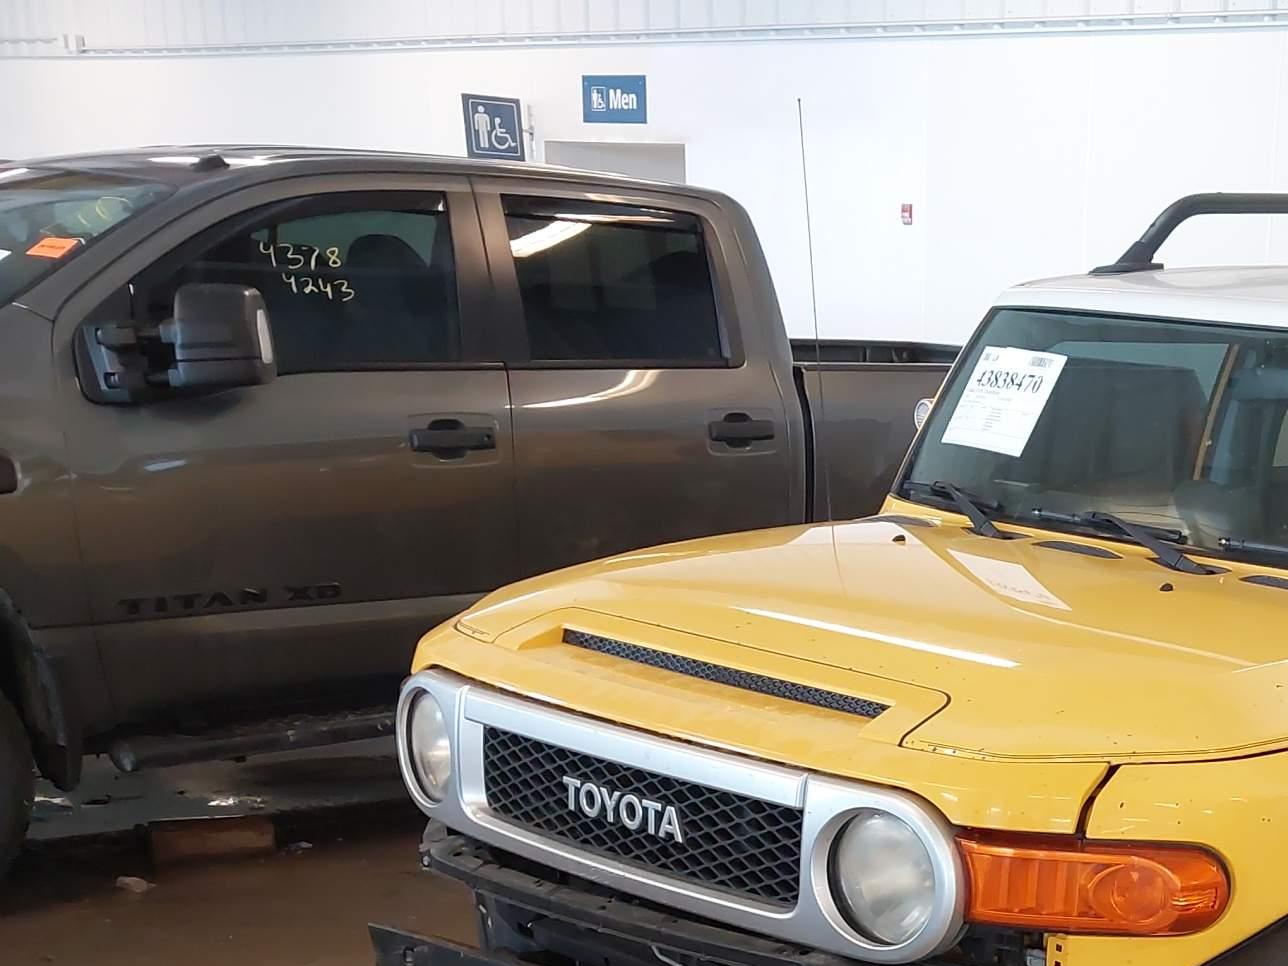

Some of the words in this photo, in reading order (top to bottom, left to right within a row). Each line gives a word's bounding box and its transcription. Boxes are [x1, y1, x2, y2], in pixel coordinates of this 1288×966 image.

[608, 88, 637, 110] Men
[259, 241, 342, 271] 4378
[281, 272, 355, 302] 4243
[976, 369, 1044, 394] 43838470
[117, 588, 268, 615] TITAN
[284, 582, 343, 601] XD
[562, 775, 683, 844] TOYOTA
